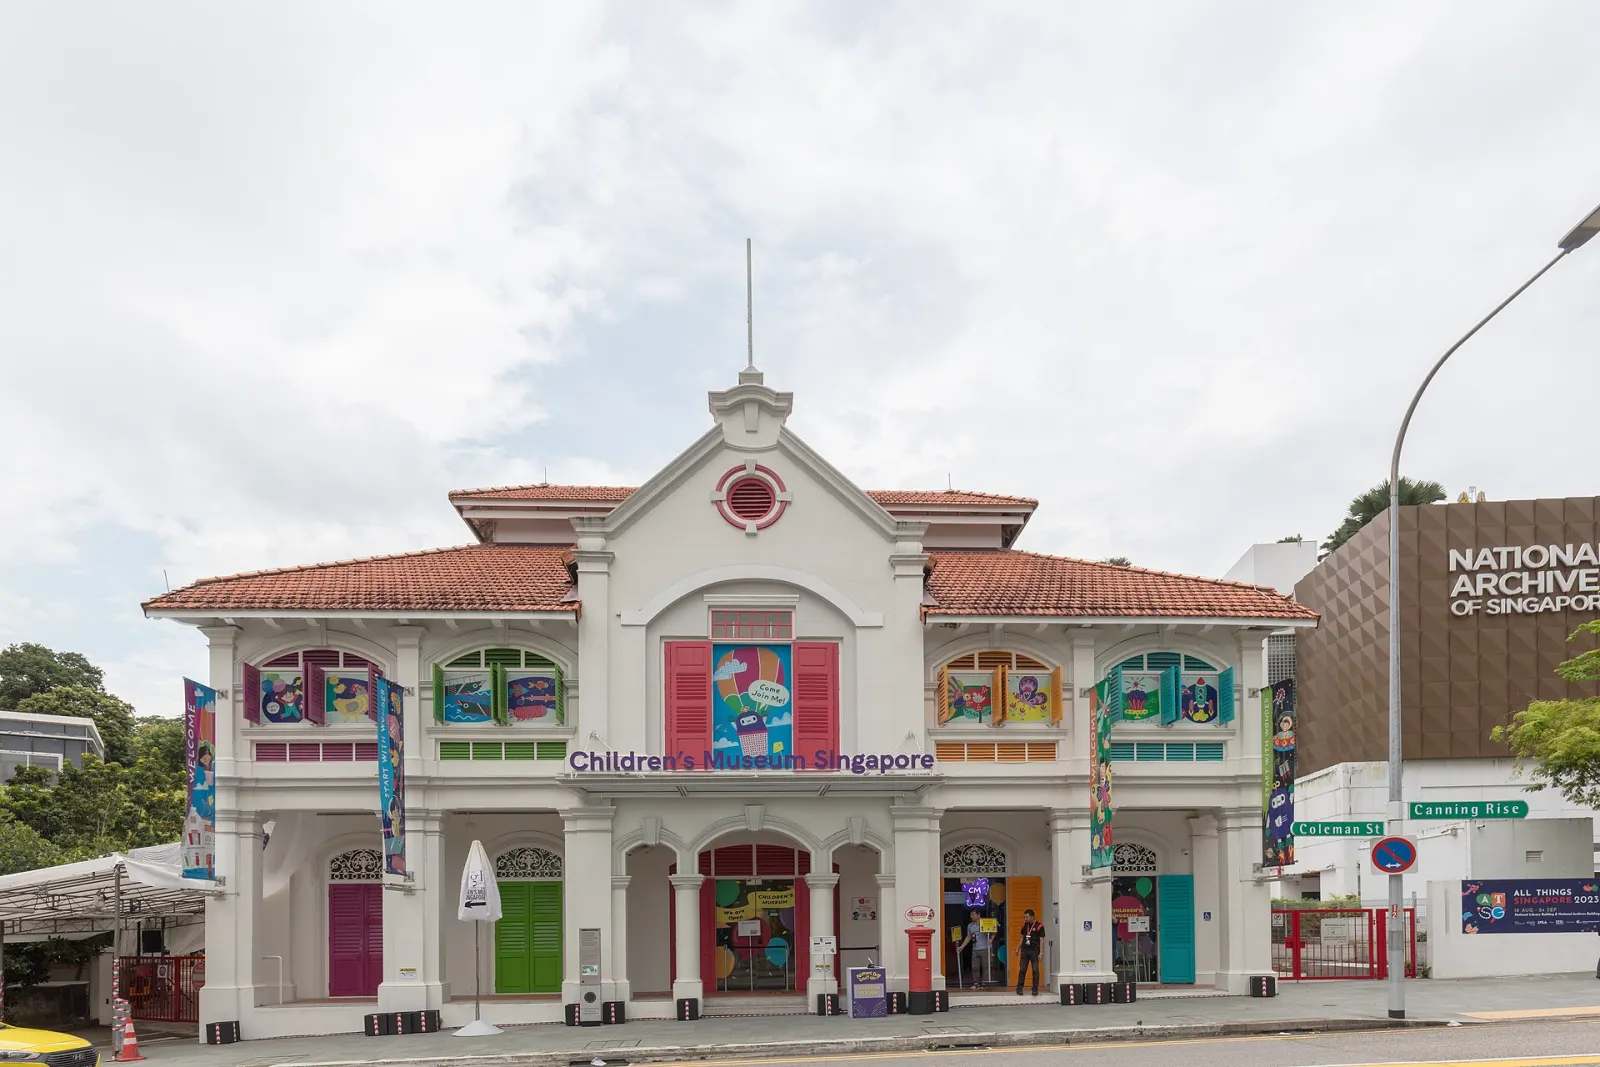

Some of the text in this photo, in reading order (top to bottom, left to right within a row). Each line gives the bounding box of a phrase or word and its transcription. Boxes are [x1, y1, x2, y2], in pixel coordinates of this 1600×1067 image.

[1449, 543, 1600, 571] NATIONA
[1451, 599, 1482, 616] OF
[760, 684, 780, 694] Come
[752, 690, 786, 704] Join Me!
[186, 702, 196, 783] WELCOME
[569, 749, 935, 774] Children's Museum Singapore
[1414, 803, 1520, 817] Canning Rise
[1300, 823, 1381, 834] Coleman St
[1536, 888, 1572, 896] THINGS
[1514, 896, 1600, 904] SINGAPORE 2023
